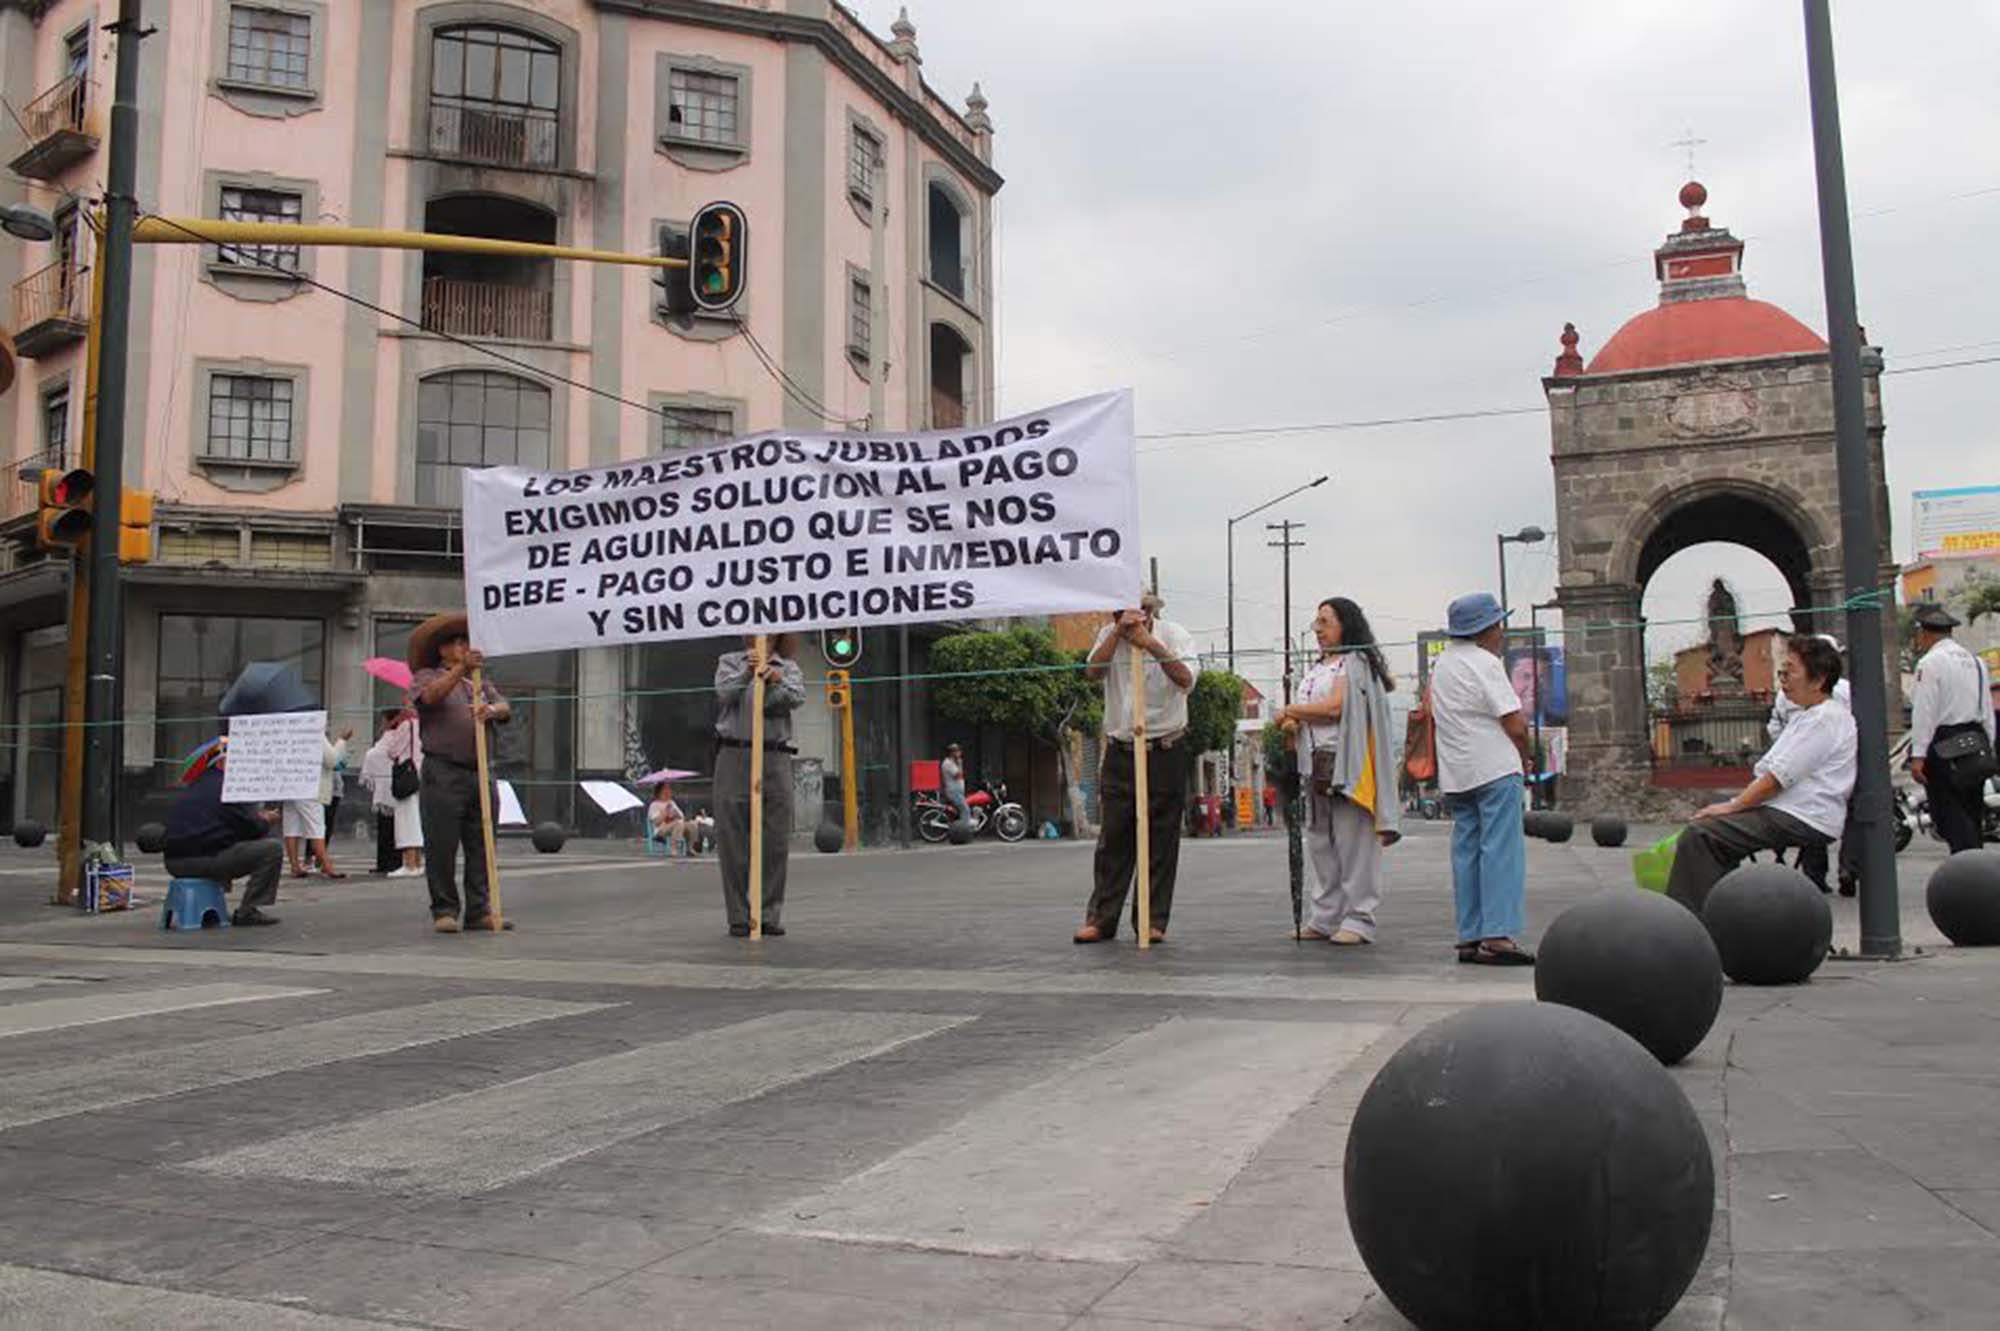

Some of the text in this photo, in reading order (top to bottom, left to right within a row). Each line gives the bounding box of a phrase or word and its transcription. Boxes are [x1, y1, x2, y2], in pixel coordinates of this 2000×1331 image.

[504, 447, 1078, 537] EXIGIMOS SOLUCION AL PAGO
[523, 417, 1051, 498] LOS MAESTROS JUBILADOS
[482, 577, 567, 611] DEBE
[597, 565, 694, 599] PAGO
[705, 551, 832, 589] JUSTO
[846, 547, 870, 578] E
[883, 527, 1121, 574] INMEDIATO
[527, 492, 1057, 571] DE AGUINALDO QUE SE NOS
[587, 580, 974, 637] Y SIN CONDICIONES
